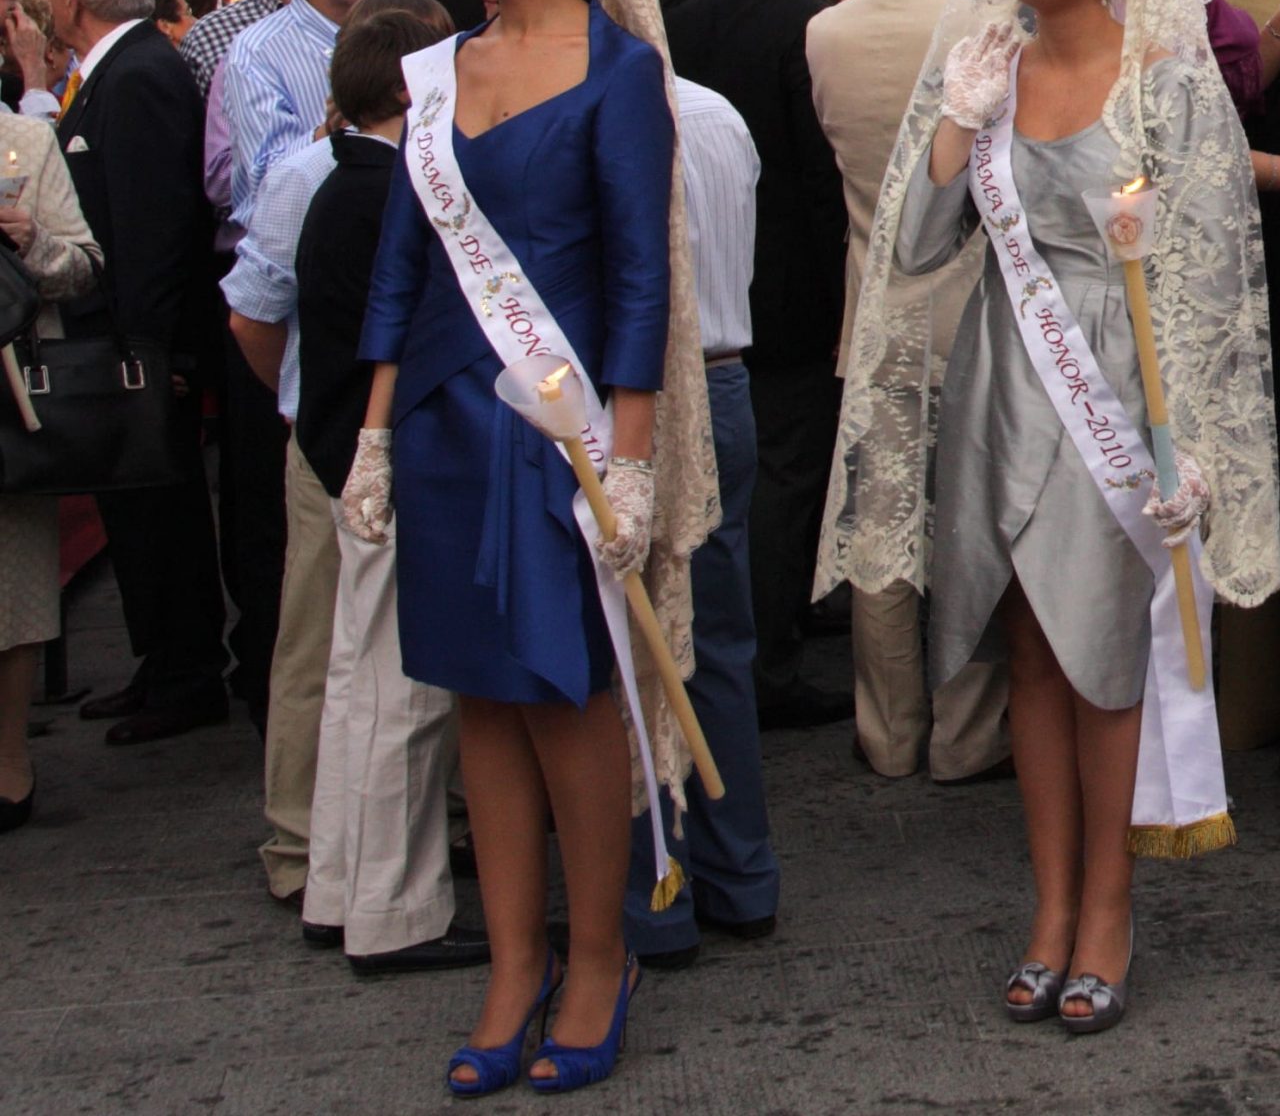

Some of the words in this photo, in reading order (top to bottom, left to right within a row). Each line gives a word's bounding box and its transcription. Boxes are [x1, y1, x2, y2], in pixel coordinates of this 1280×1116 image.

[417, 132, 456, 213] DAMA
[458, 234, 494, 275] DE
[975, 134, 1004, 213] DAMA
[1005, 237, 1031, 277] DE
